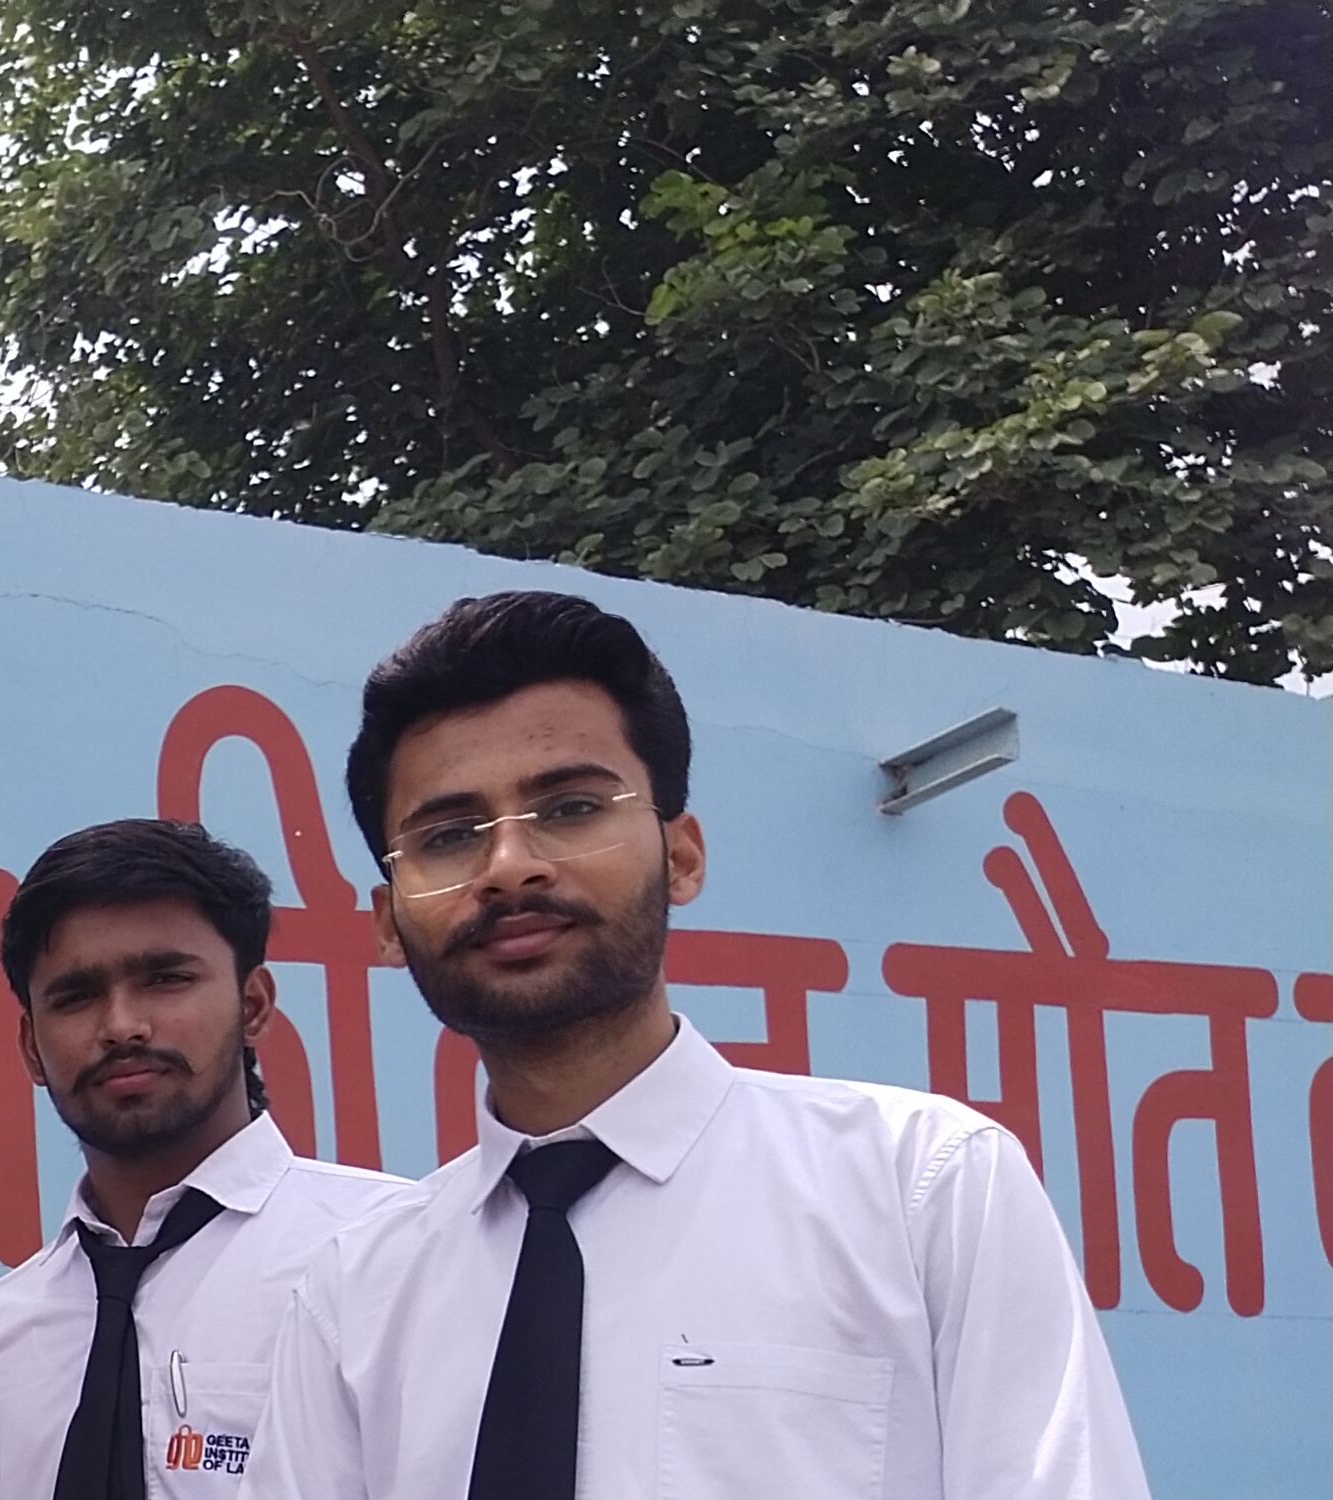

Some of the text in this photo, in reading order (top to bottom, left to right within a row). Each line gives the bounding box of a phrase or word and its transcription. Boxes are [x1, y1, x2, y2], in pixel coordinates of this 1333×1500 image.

[882, 791, 1278, 1318] मौत
[206, 1434, 250, 1450] GEETA
[203, 1459, 222, 1472] OF
